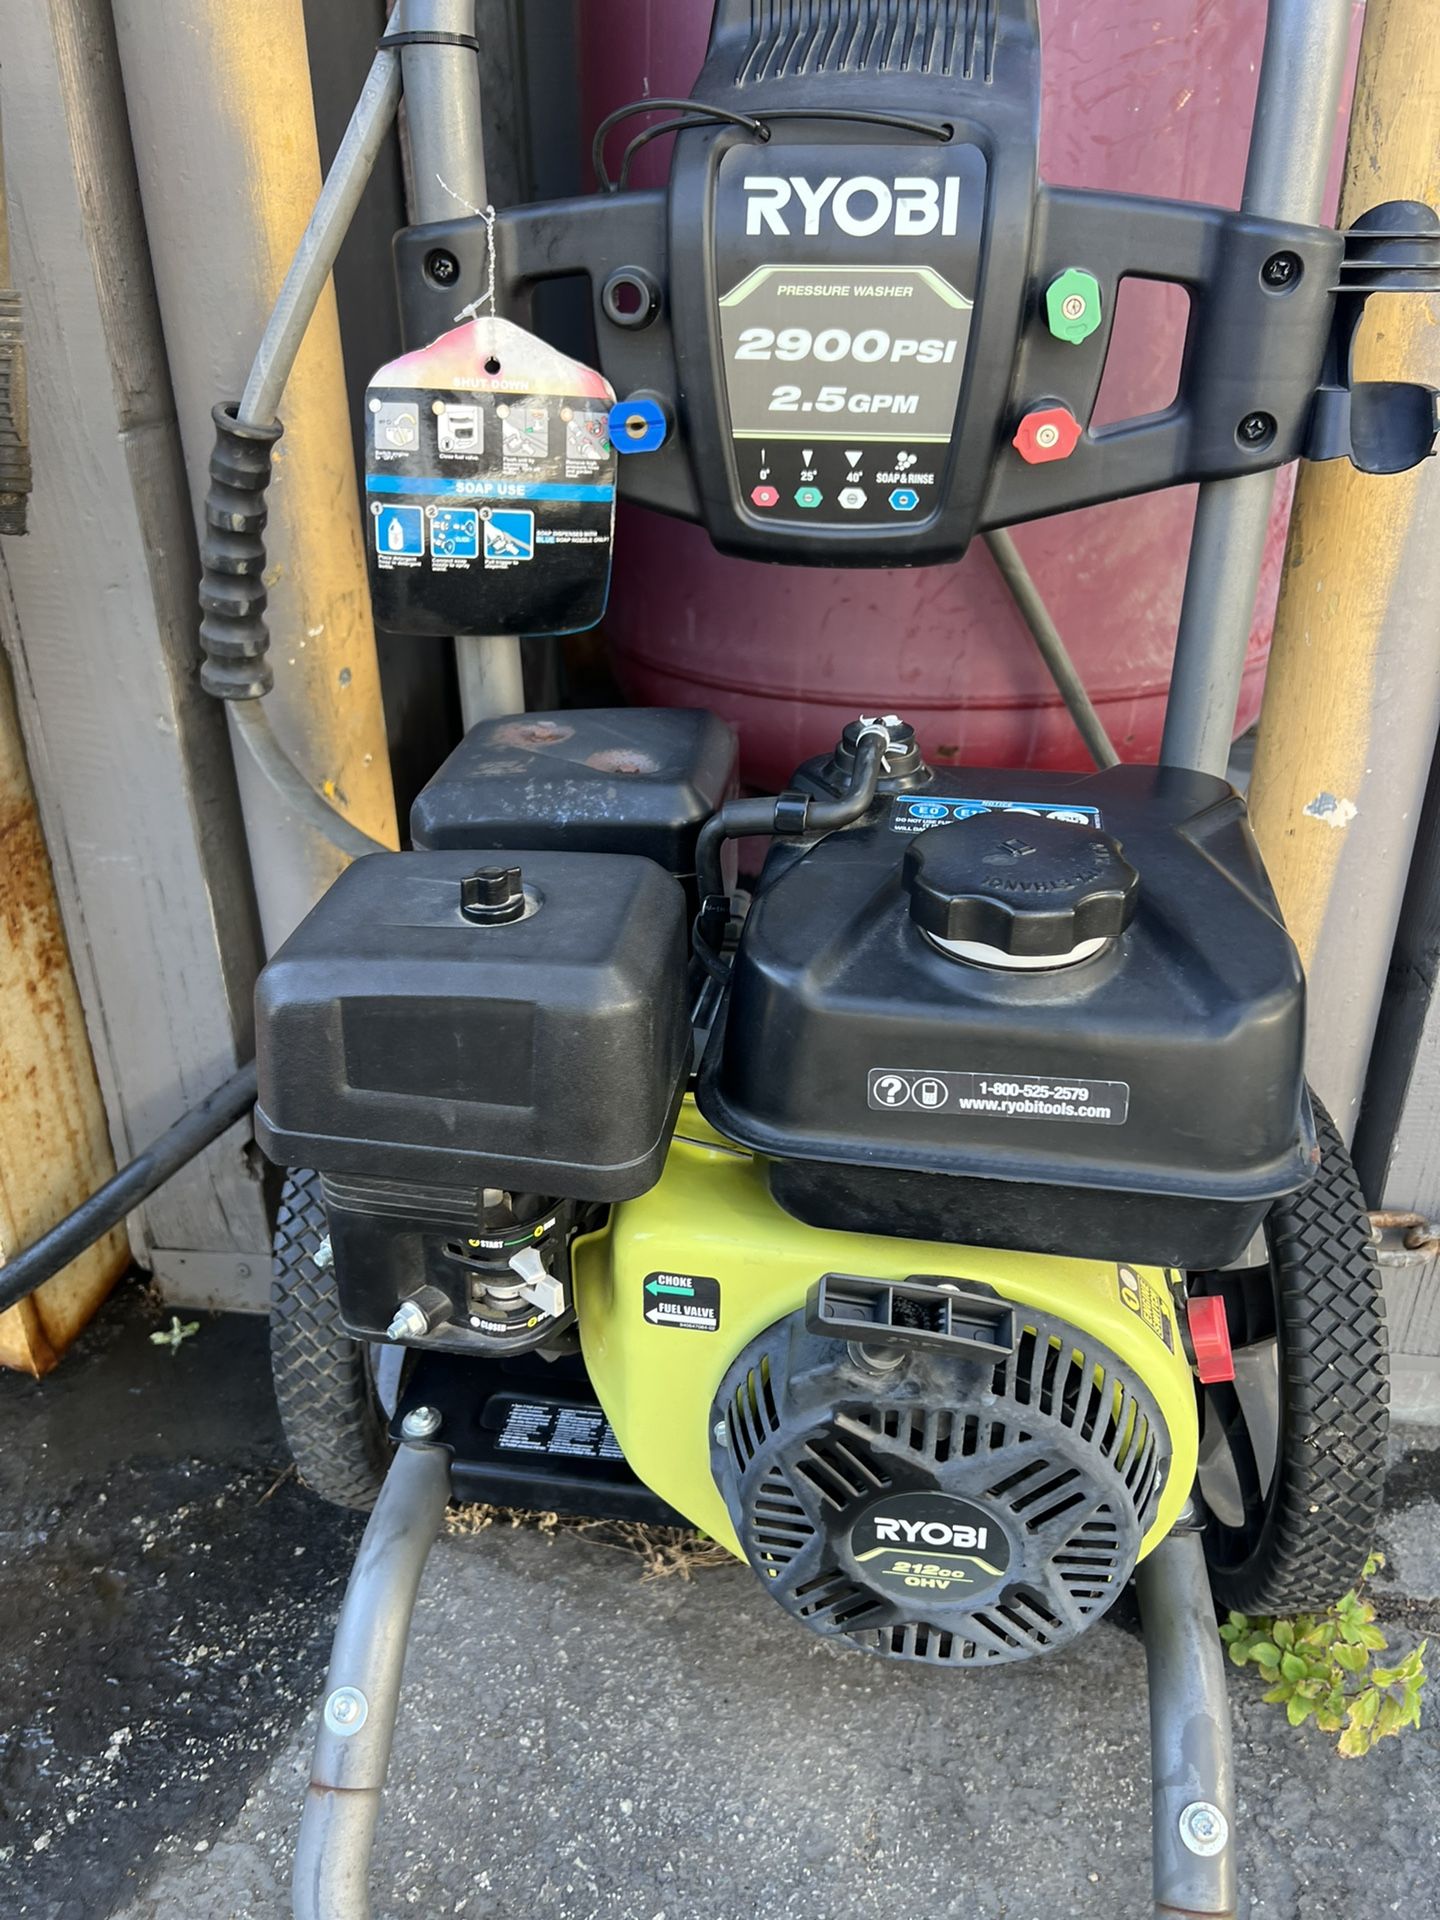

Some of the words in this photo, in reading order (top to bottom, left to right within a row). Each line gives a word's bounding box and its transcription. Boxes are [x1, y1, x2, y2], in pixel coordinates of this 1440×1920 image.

[743, 176, 960, 236] RYOBI
[777, 285, 850, 297] PRESSURE
[853, 286, 913, 298] WASHER
[453, 378, 485, 388] SHUT
[491, 380, 528, 390] DOWN
[876, 474, 900, 484] SOAP
[907, 474, 935, 485] RINSE
[455, 482, 493, 494] SOAP
[497, 484, 525, 496] USE
[979, 1081, 1089, 1101] 1-800-525-2579
[959, 1097, 1111, 1119] www.ryobitools.com
[658, 1274, 693, 1288] CHOKE
[659, 1302, 682, 1315] FUEL
[683, 1305, 714, 1318] VALVE
[481, 1320, 507, 1332] CLOSED
[874, 1517, 987, 1549] RYOBI
[892, 1561, 965, 1579] 212cc
[904, 1576, 951, 1589] OHV
